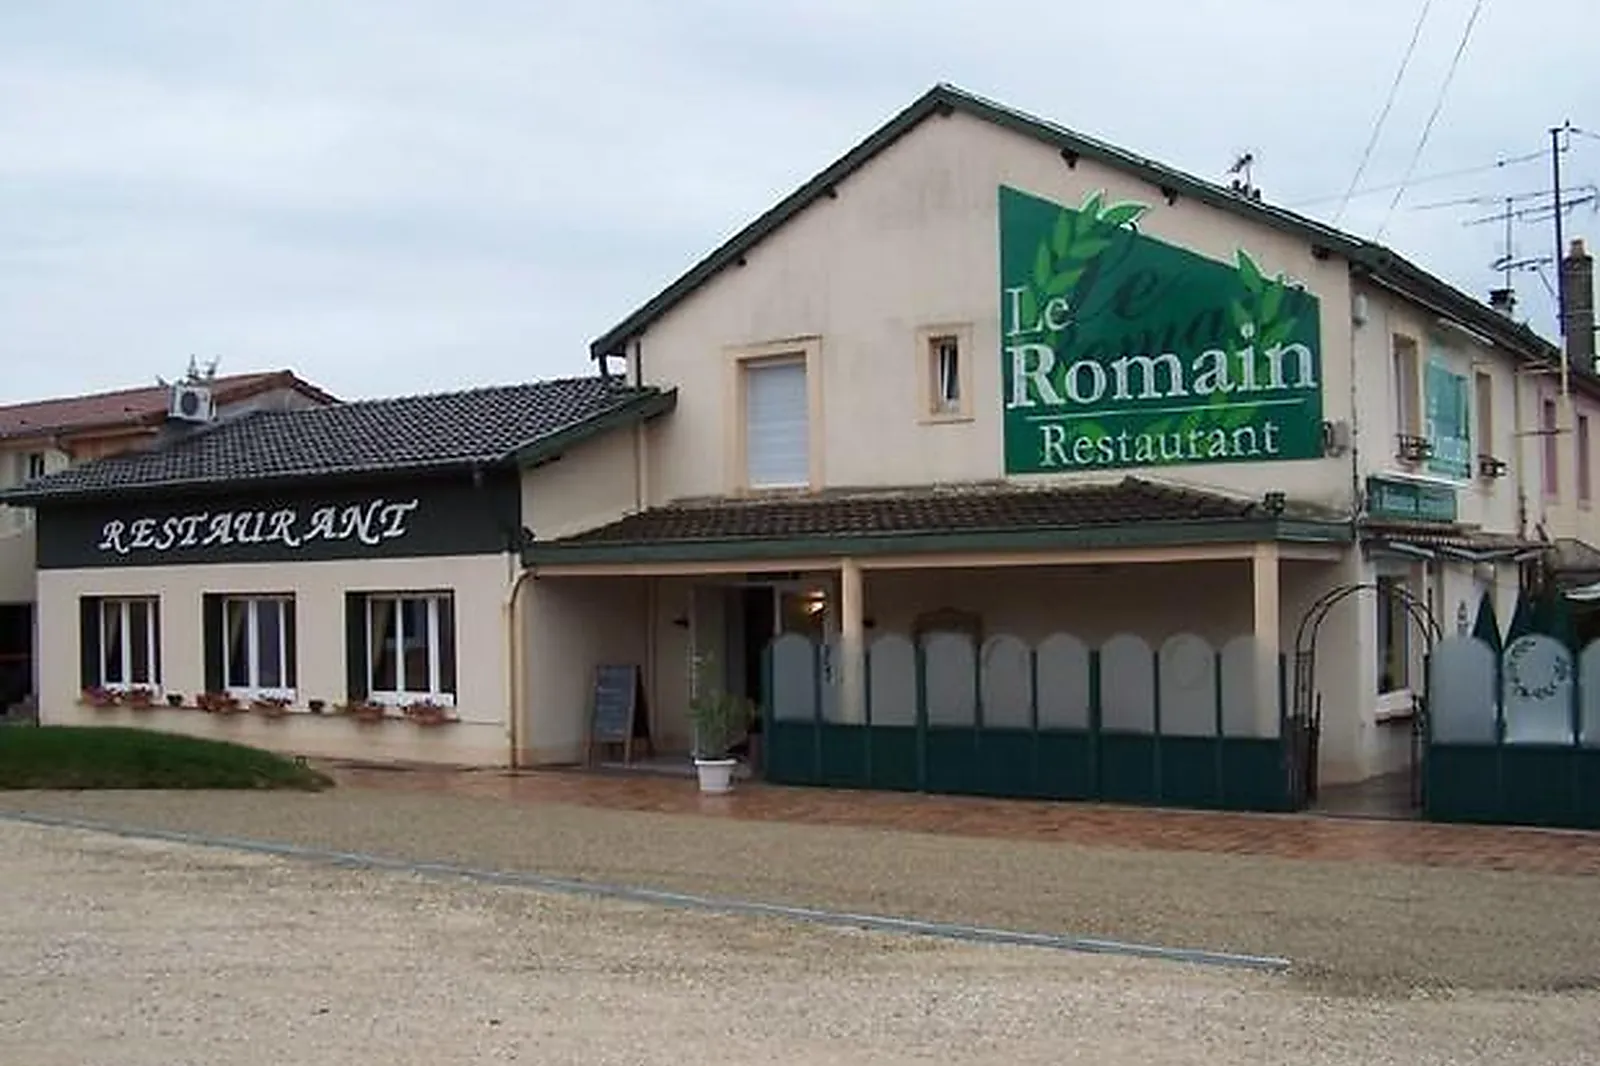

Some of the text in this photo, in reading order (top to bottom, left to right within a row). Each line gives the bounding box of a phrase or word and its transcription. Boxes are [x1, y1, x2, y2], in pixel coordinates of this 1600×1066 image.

[1005, 286, 1070, 336] Le
[1005, 324, 1317, 409] Romain
[1039, 422, 1279, 467] Restaurant
[98, 499, 418, 554] RESTAURANT
